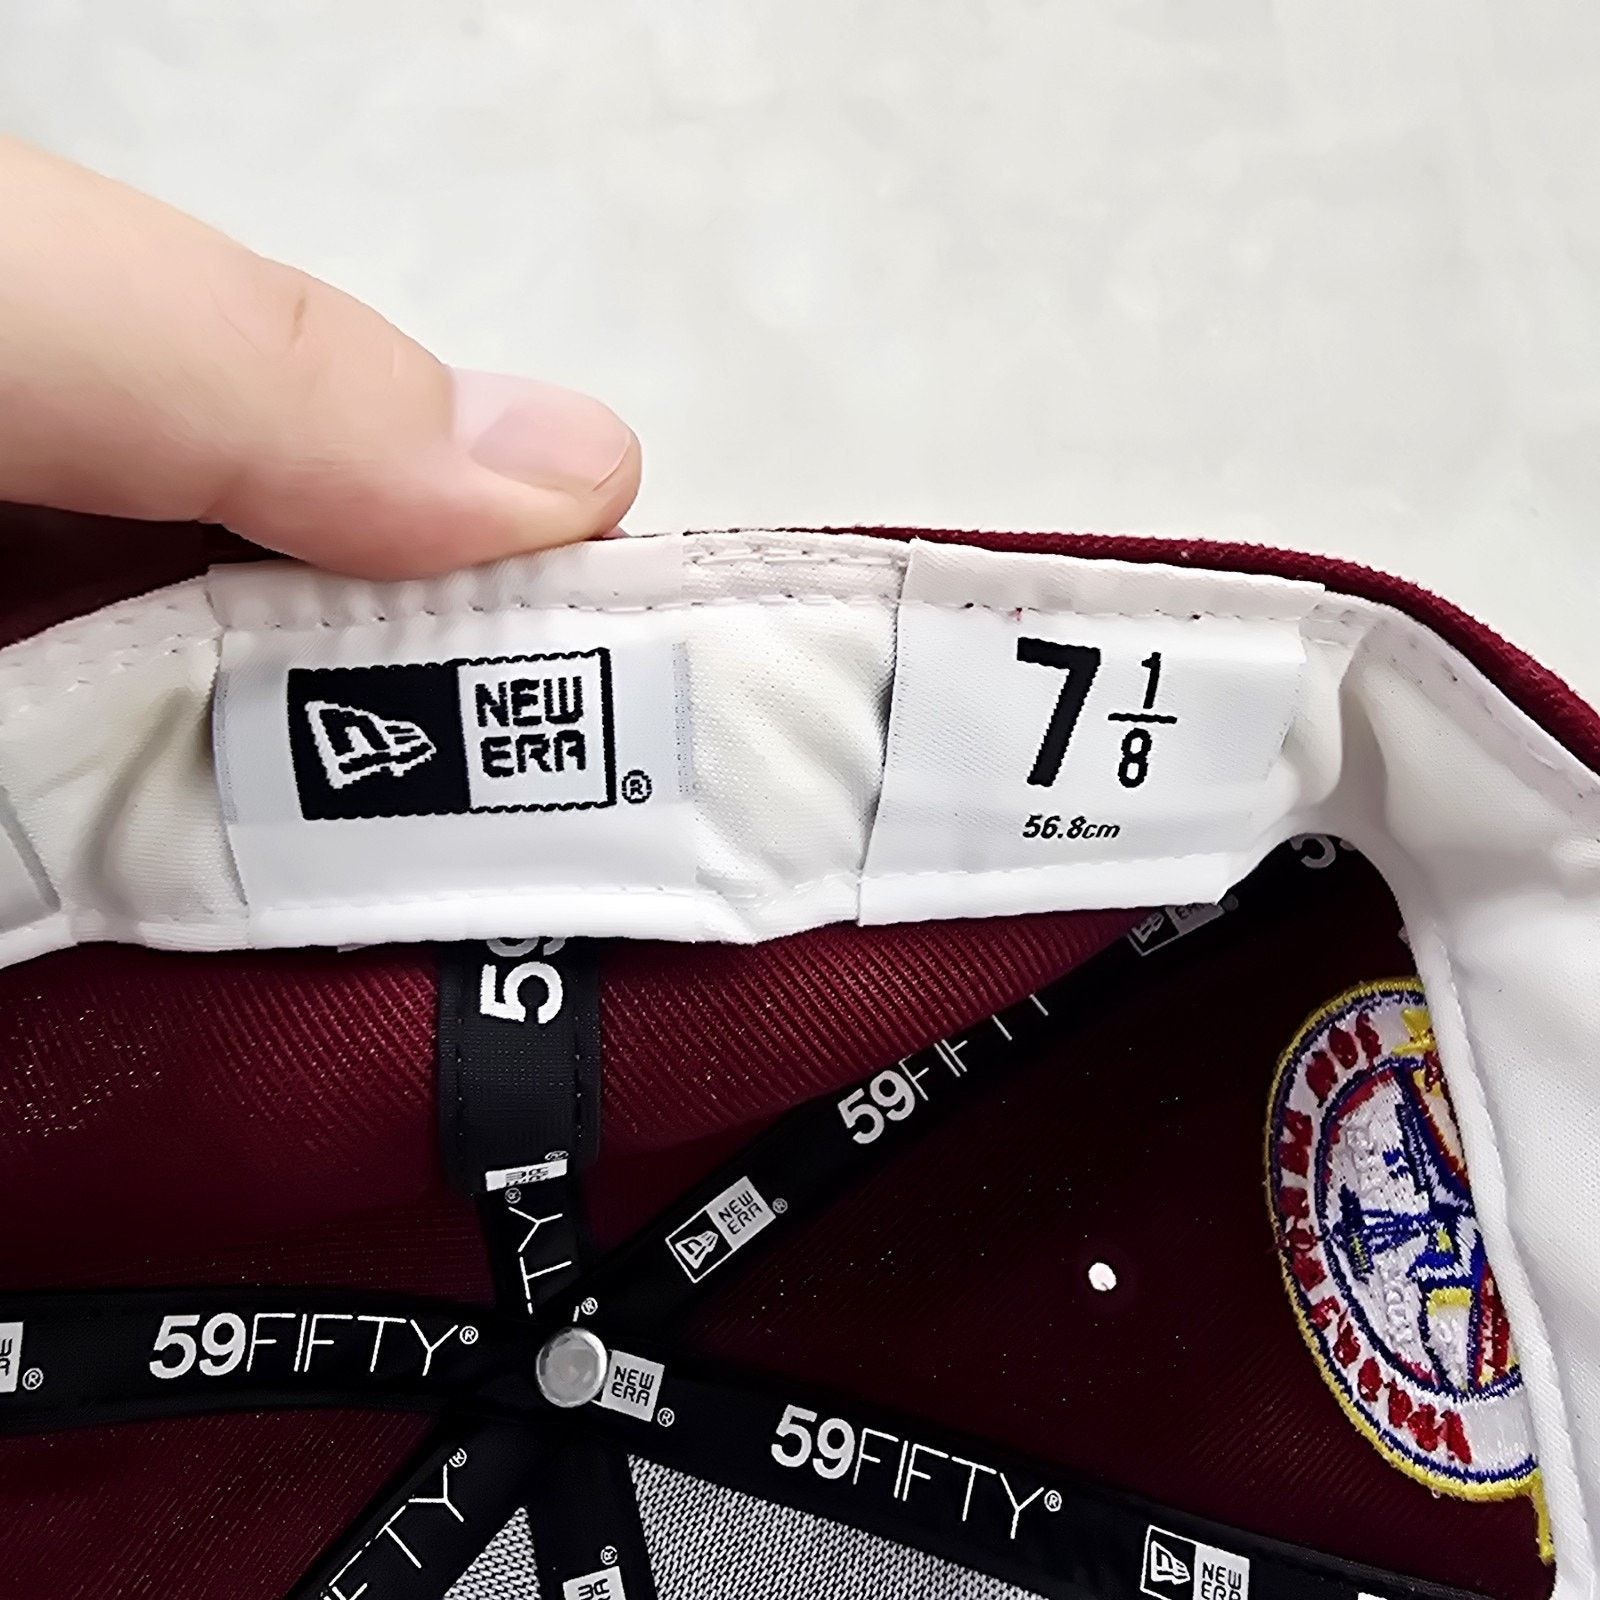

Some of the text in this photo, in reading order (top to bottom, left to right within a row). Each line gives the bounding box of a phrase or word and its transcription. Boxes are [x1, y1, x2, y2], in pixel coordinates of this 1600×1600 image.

[475, 676, 584, 728] NEW
[1017, 637, 1102, 788] 7
[480, 730, 587, 778] ERA
[1022, 814, 1121, 840] 56.8cm
[718, 1190, 754, 1223] NEW
[727, 1202, 764, 1235] ERA
[611, 1381, 650, 1407] ERA
[614, 1365, 655, 1391] NEW
[1201, 1561, 1242, 1590] NEW
